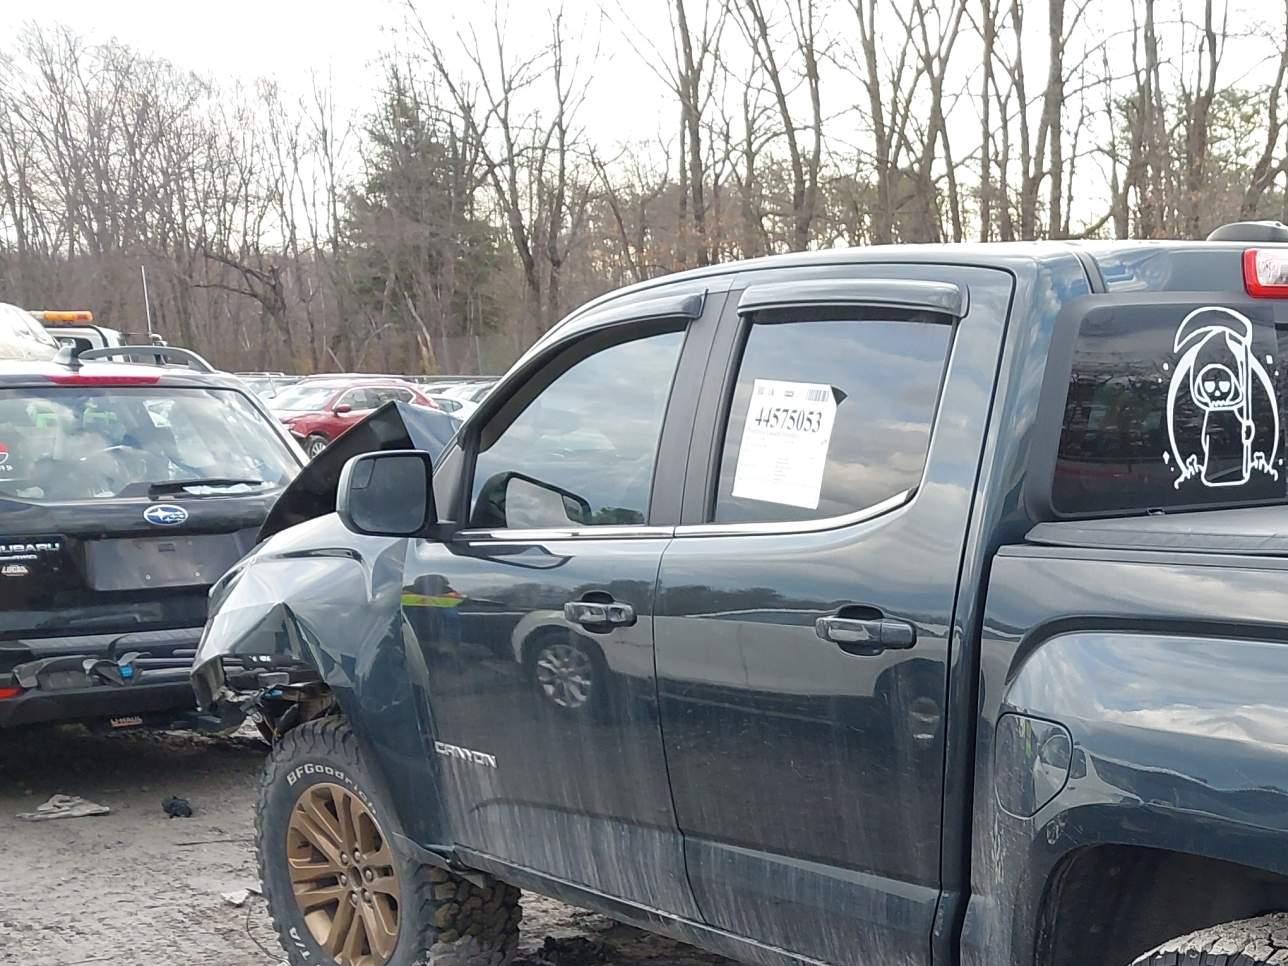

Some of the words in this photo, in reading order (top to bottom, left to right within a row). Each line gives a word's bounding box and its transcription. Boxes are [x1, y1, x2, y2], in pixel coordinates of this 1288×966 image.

[755, 408, 822, 433] 44575053
[0, 543, 60, 553] UBARU
[434, 740, 497, 769] CANYON
